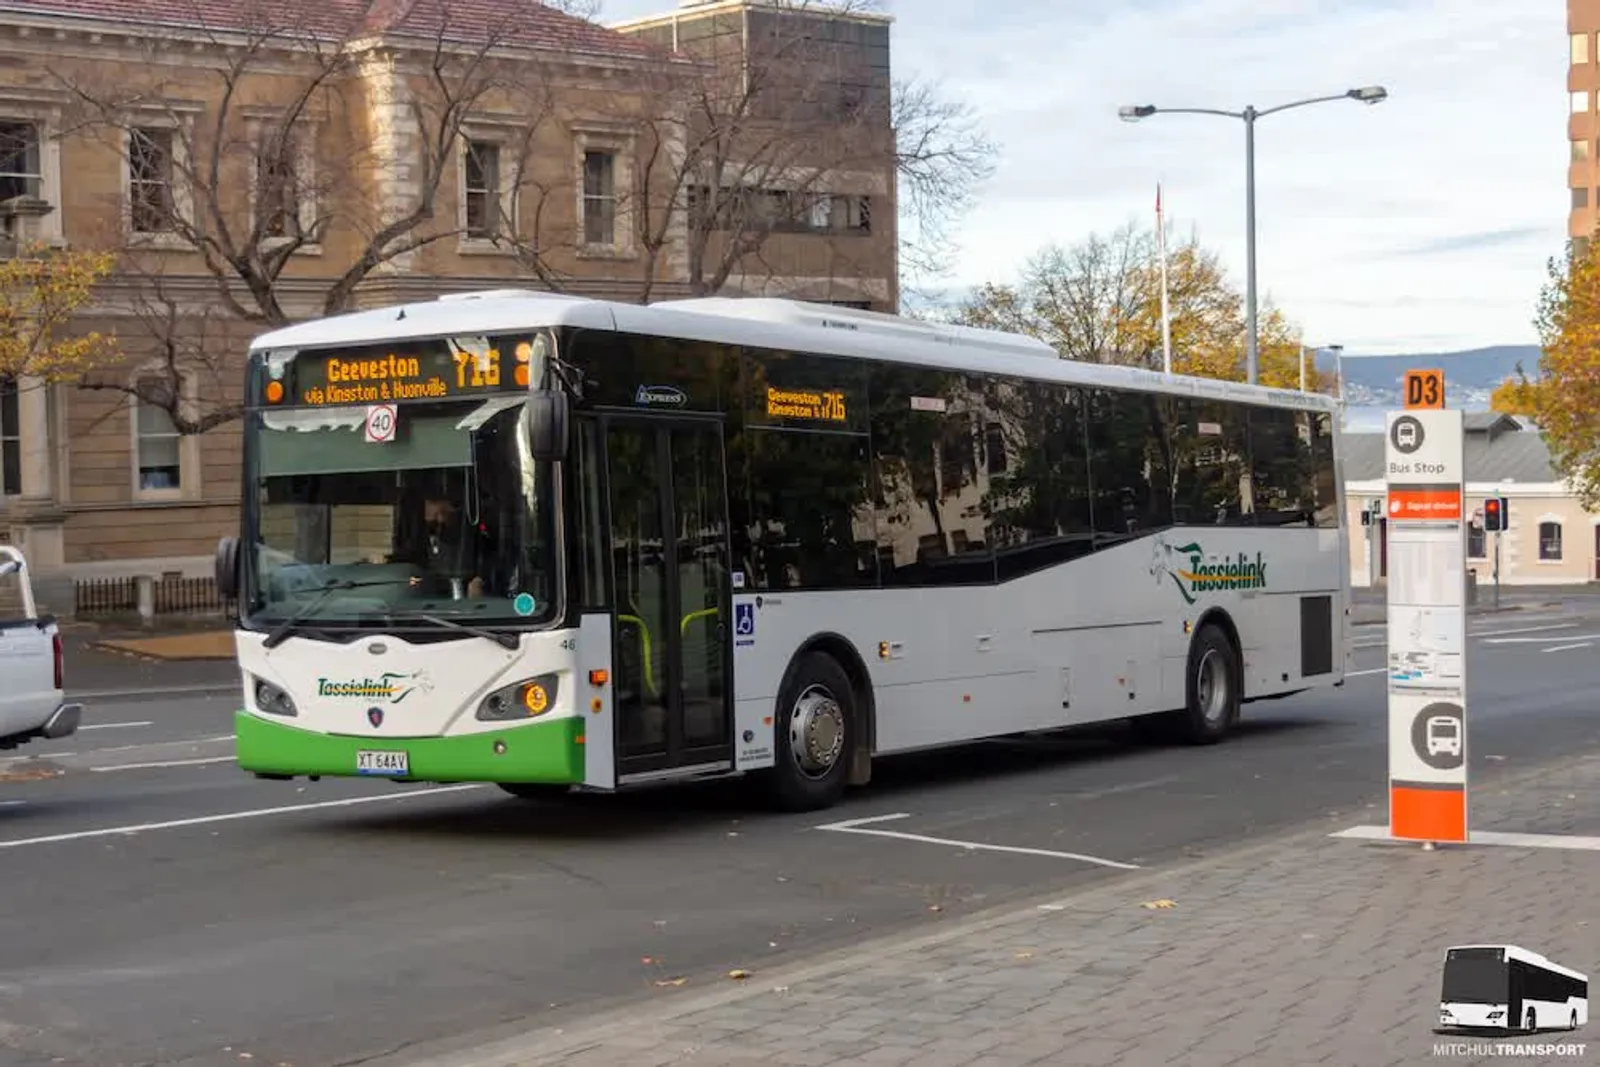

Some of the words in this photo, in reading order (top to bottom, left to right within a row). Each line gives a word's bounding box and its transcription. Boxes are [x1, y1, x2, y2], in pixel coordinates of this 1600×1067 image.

[327, 354, 419, 382] Geeveston
[304, 386, 324, 404] via
[380, 381, 391, 399] &
[393, 376, 447, 399] Huonville
[1408, 376, 1438, 405] D3
[823, 392, 846, 419] 716
[371, 414, 391, 431] 40
[1390, 462, 1410, 474] Bus
[1414, 462, 1445, 475] Stop
[1190, 551, 1267, 592] Tassielink
[318, 678, 393, 698] Tassielink
[358, 753, 372, 768] XT
[376, 753, 405, 769] 64AV
